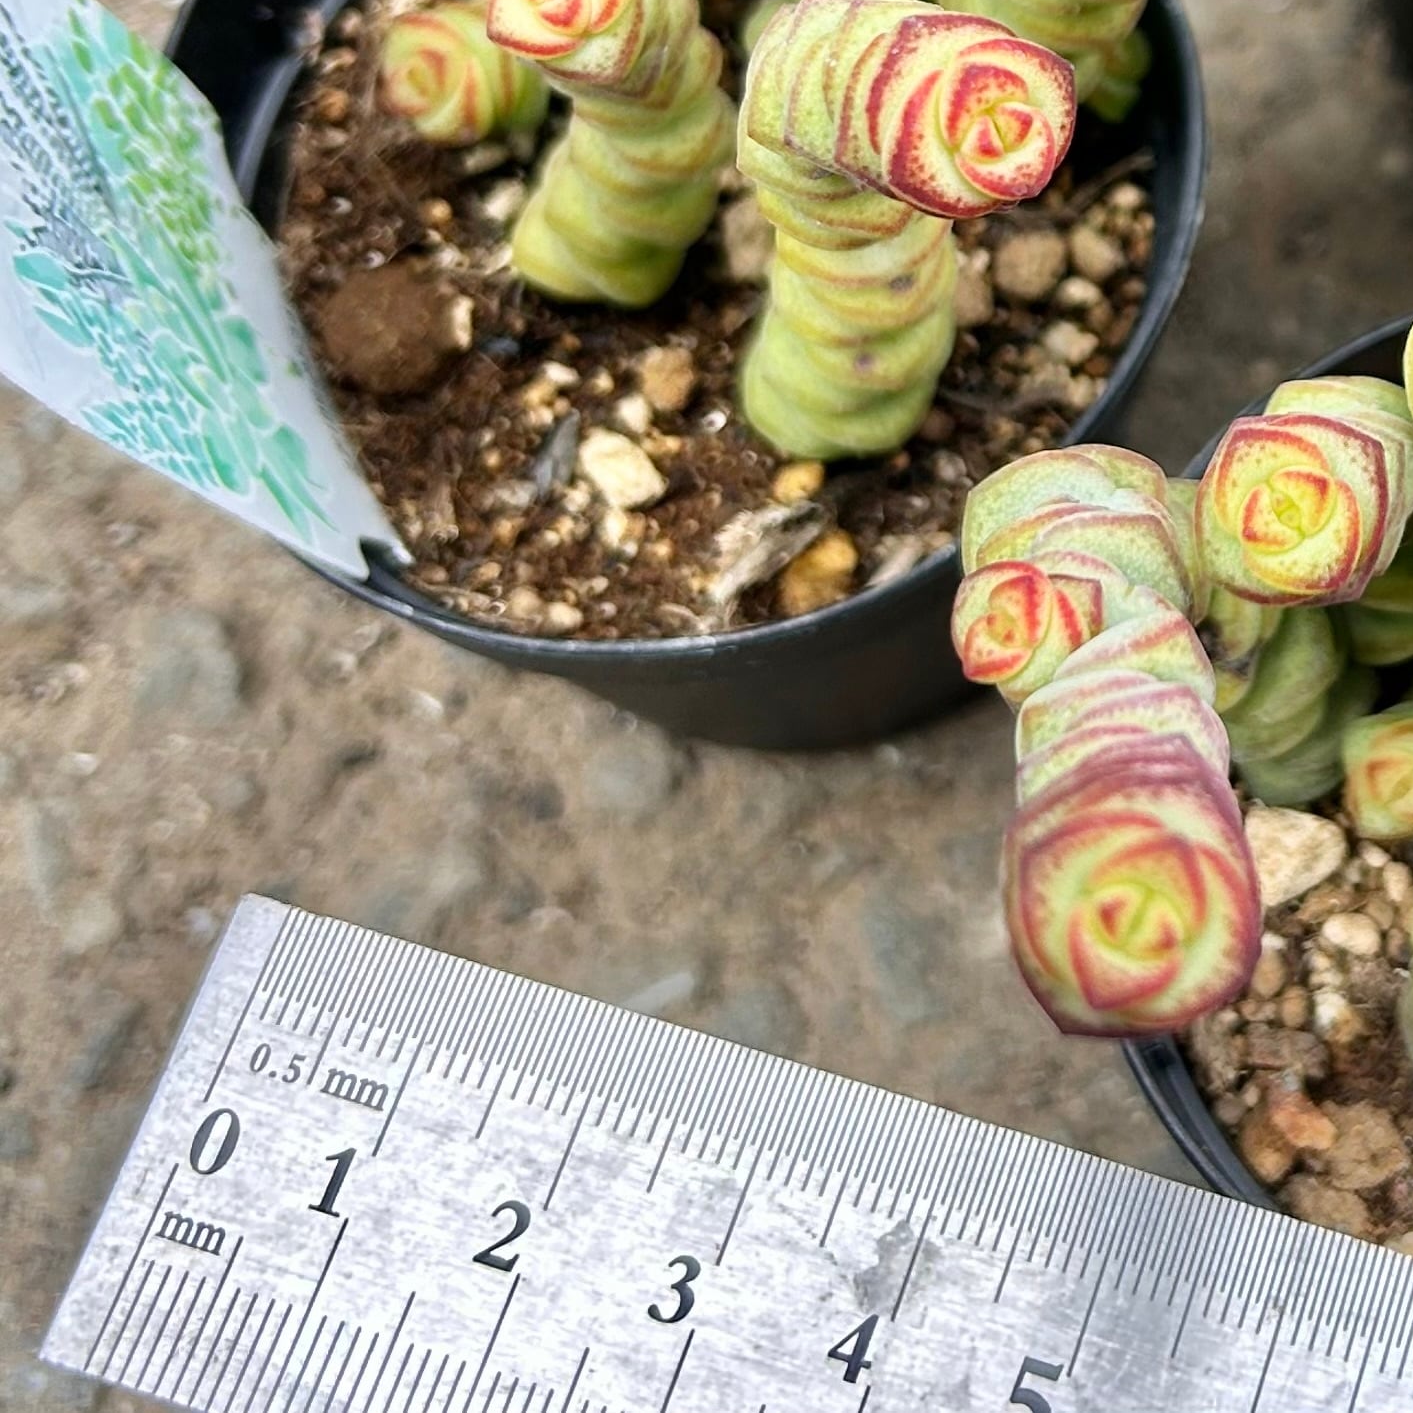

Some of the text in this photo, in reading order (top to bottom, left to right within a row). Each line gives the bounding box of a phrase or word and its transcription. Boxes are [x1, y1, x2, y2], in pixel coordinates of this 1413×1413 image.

[249, 1042, 390, 1112] 0.5 mm
[155, 1209, 227, 1257] mm
[189, 1108, 1064, 1413] 0 1 2 3 4 5
